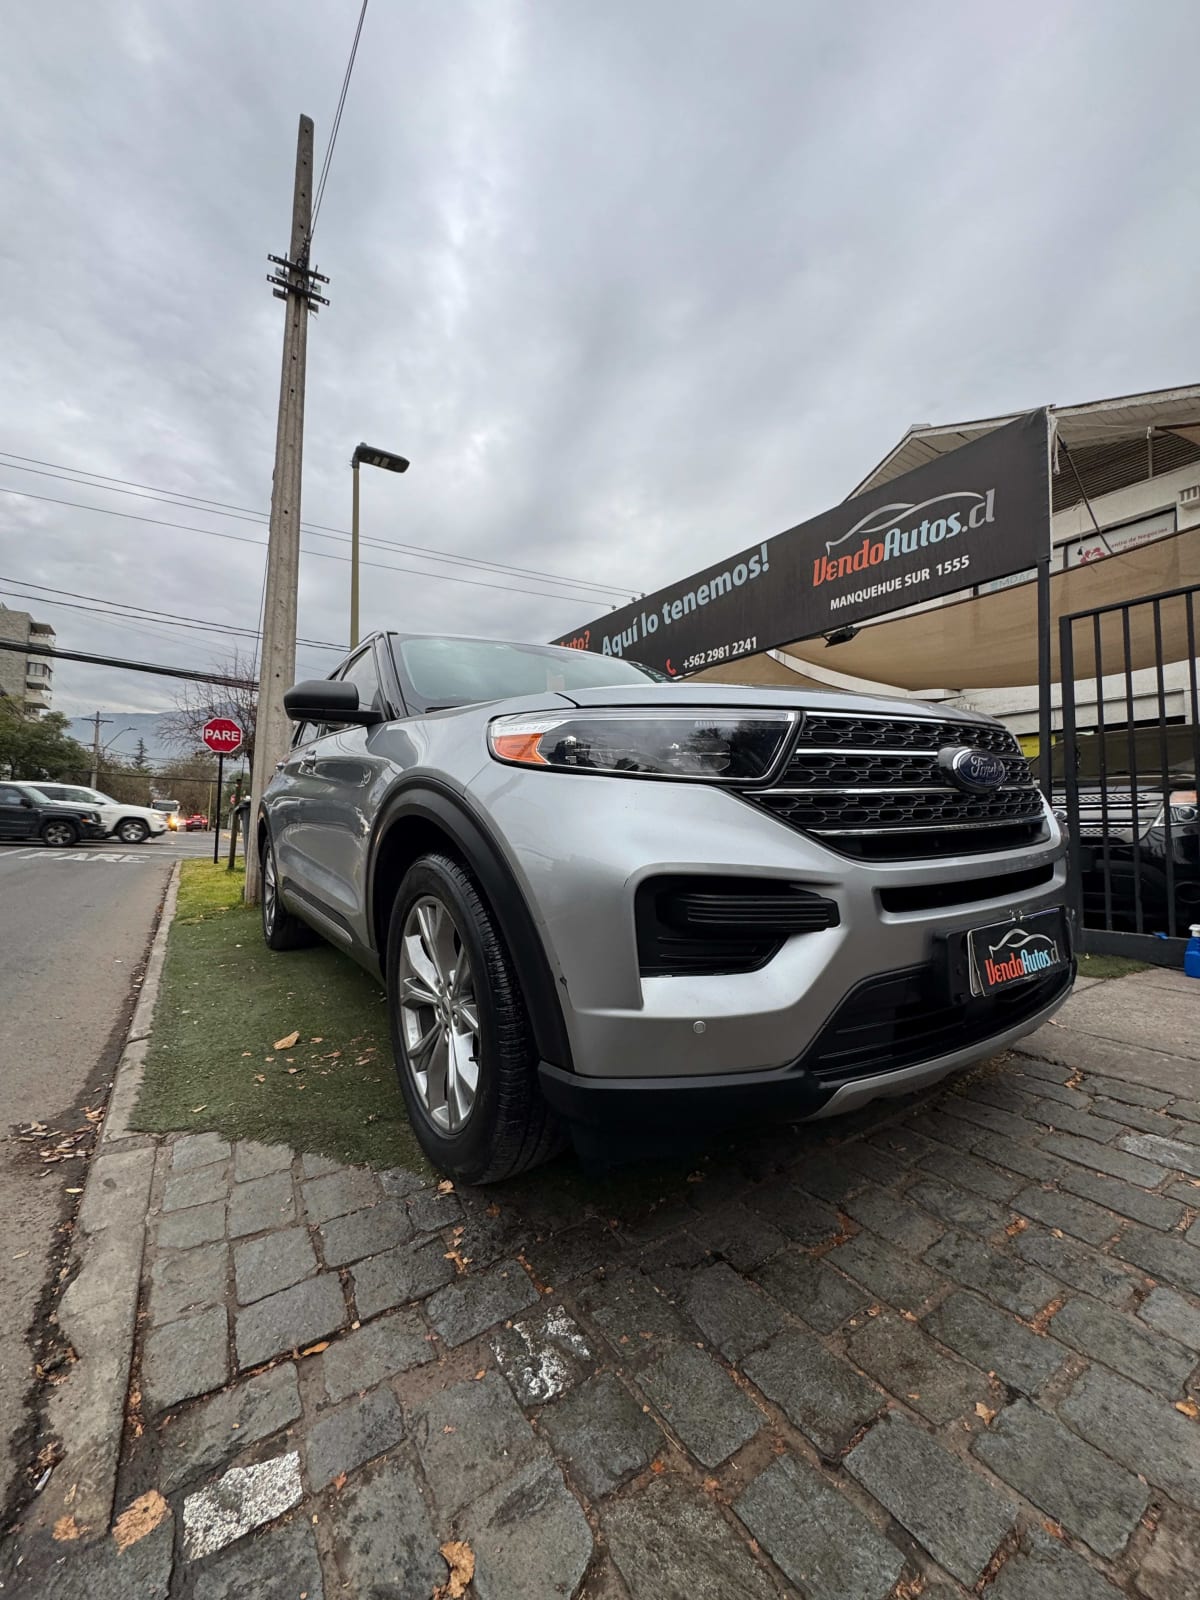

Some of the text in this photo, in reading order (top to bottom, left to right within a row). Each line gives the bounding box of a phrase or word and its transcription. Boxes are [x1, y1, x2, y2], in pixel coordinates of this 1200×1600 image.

[812, 488, 996, 587] VendoAutos.cl
[602, 542, 770, 658] Aquí lo tenemos!
[830, 555, 970, 611] MANQUEHUE SUR 1555
[682, 636, 758, 669] +562 2981 2241
[204, 728, 240, 742] PARE
[970, 755, 999, 778] Ford
[18, 851, 150, 864] PARE
[984, 940, 1061, 986] VendoAutos.cl
